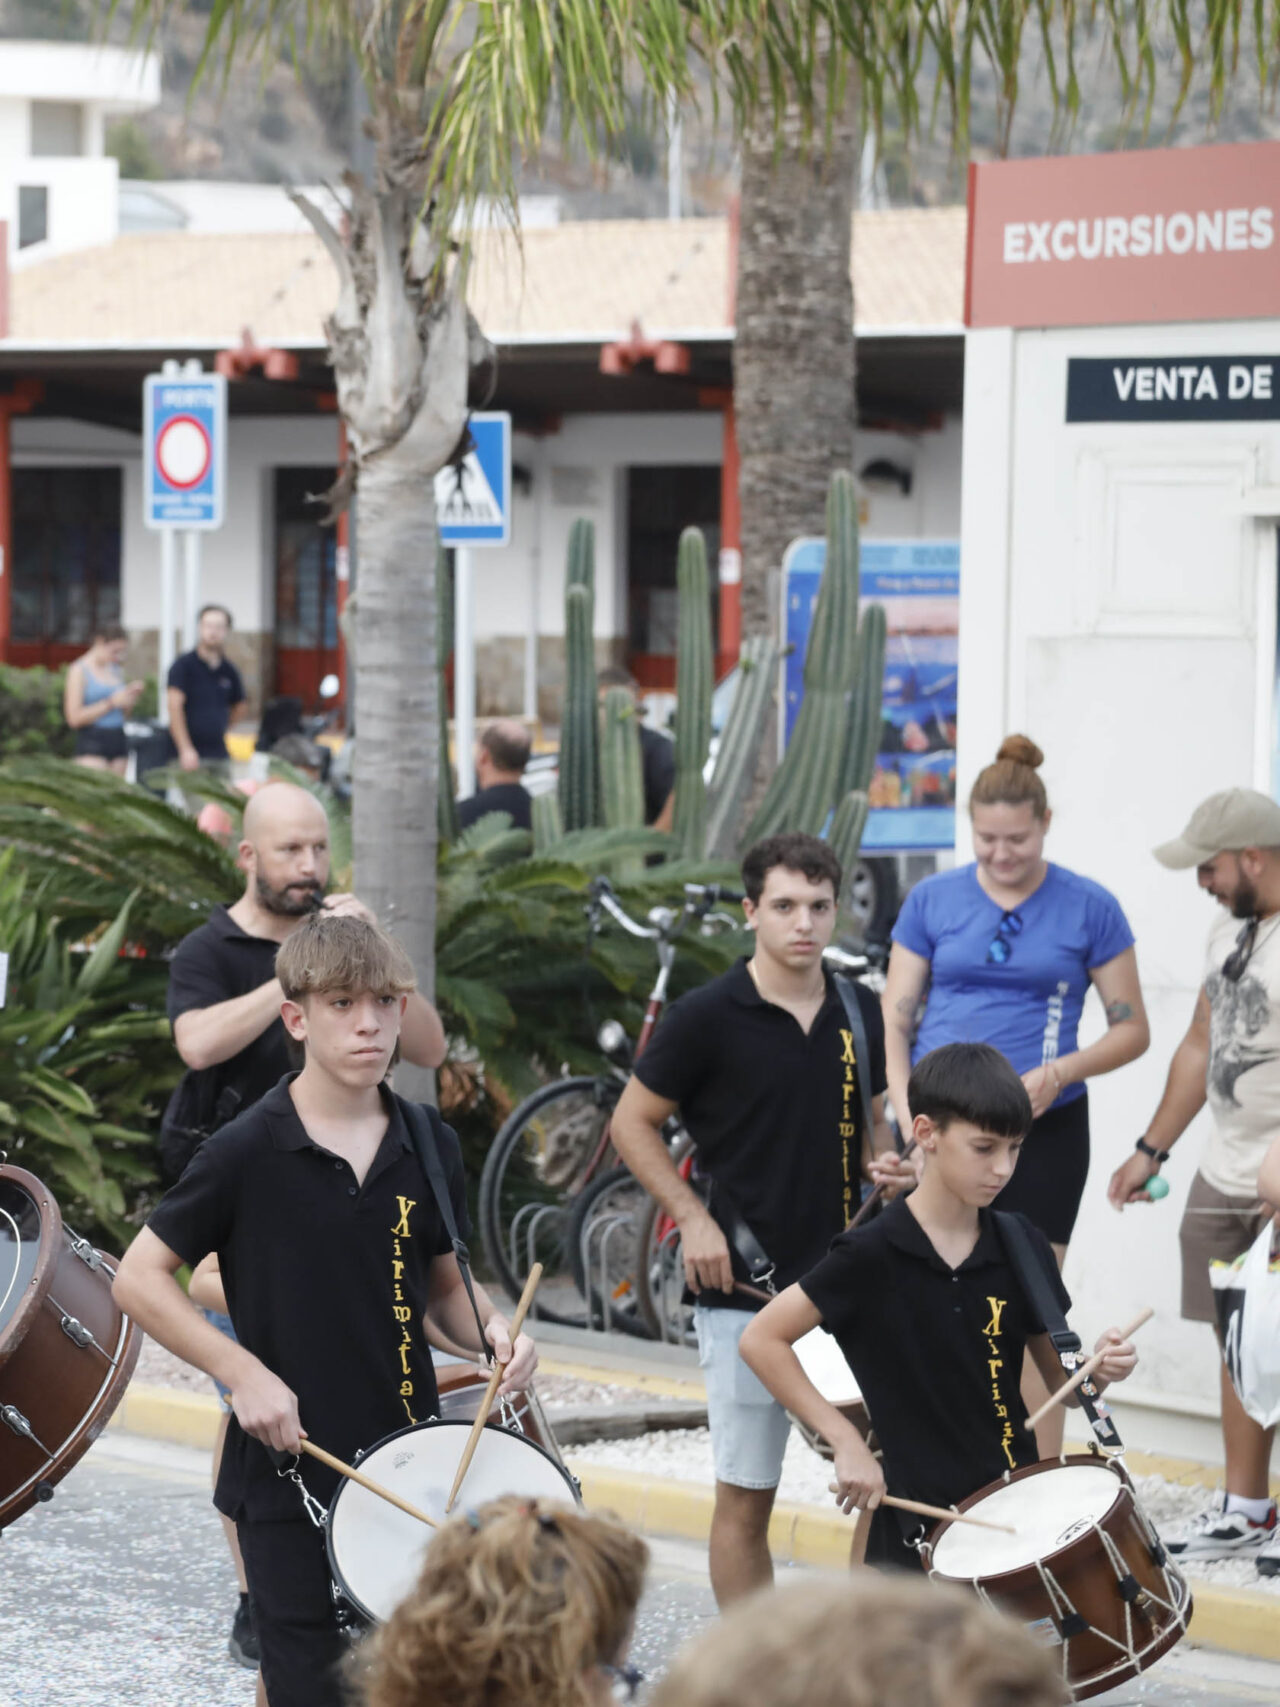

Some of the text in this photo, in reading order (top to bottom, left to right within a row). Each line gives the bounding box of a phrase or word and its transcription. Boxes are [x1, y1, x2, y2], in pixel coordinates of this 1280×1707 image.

[1003, 206, 1274, 263] EXCURSIONES
[1113, 365, 1273, 401] VENTA DE
